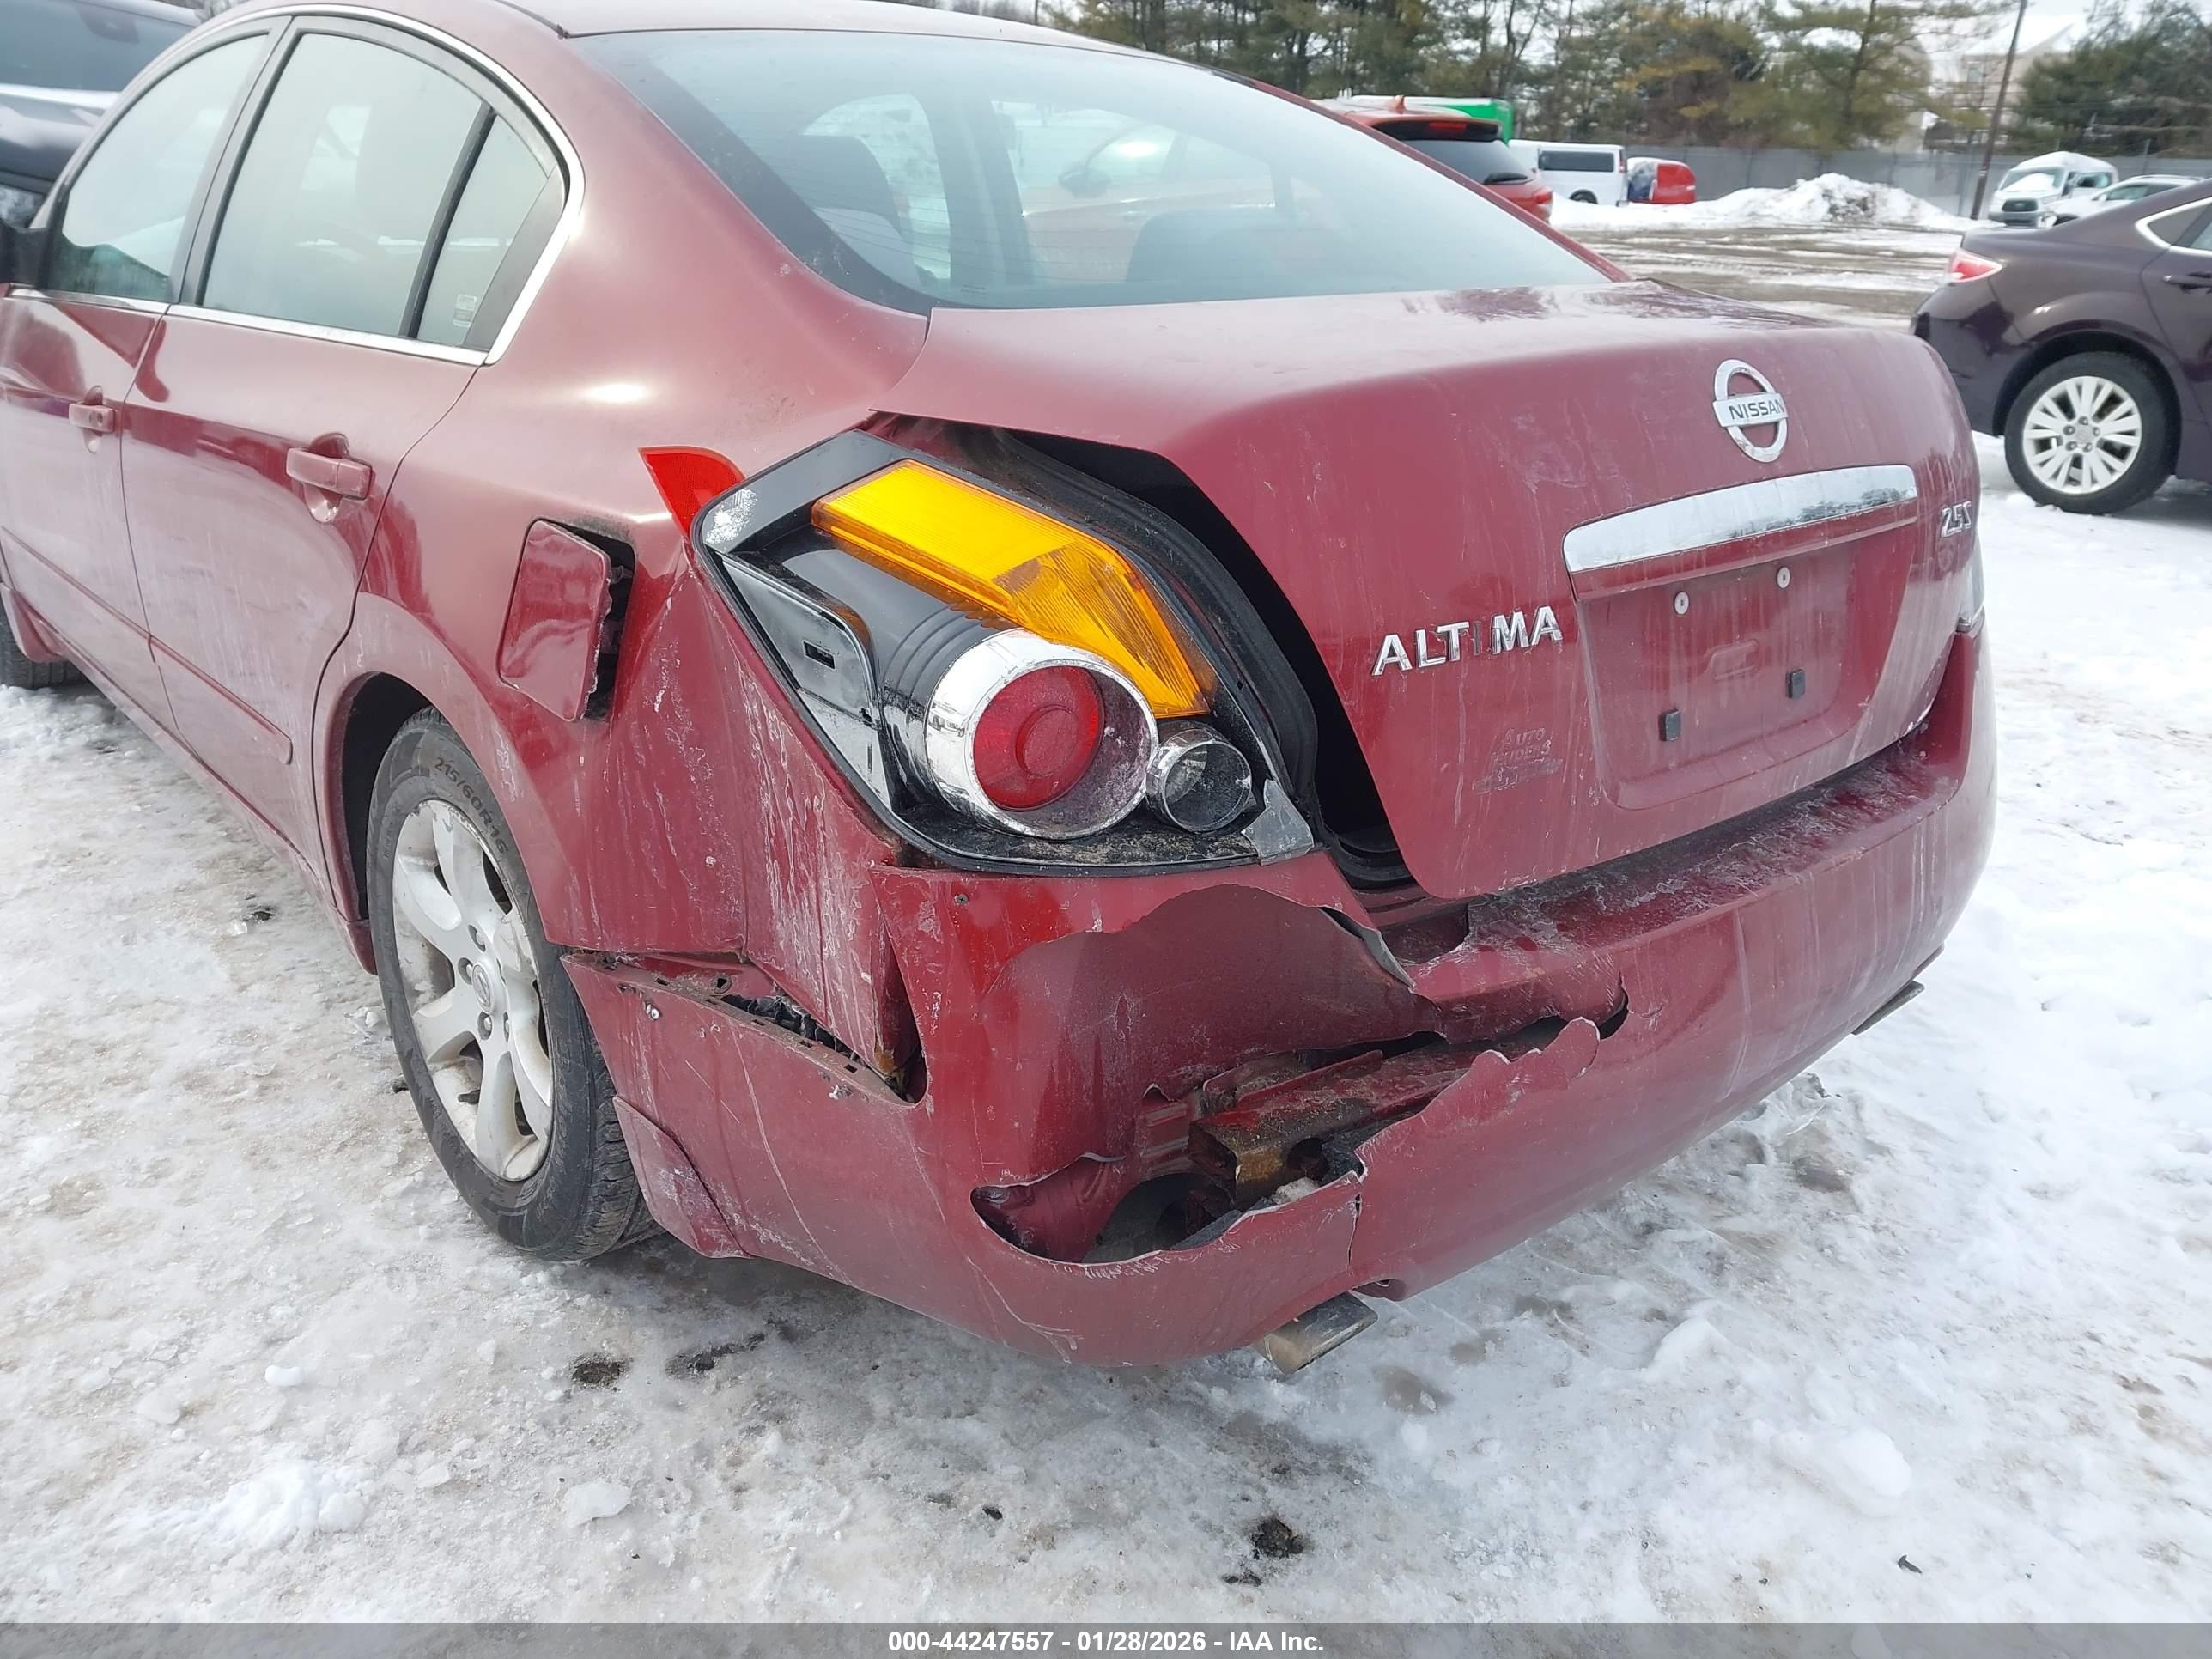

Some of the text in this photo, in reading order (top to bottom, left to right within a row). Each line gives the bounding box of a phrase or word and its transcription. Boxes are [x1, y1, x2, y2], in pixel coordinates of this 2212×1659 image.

[1728, 398, 1786, 421] NISSAN
[1370, 605, 1564, 677] ALTIMA
[434, 756, 509, 854] 215/60R16
